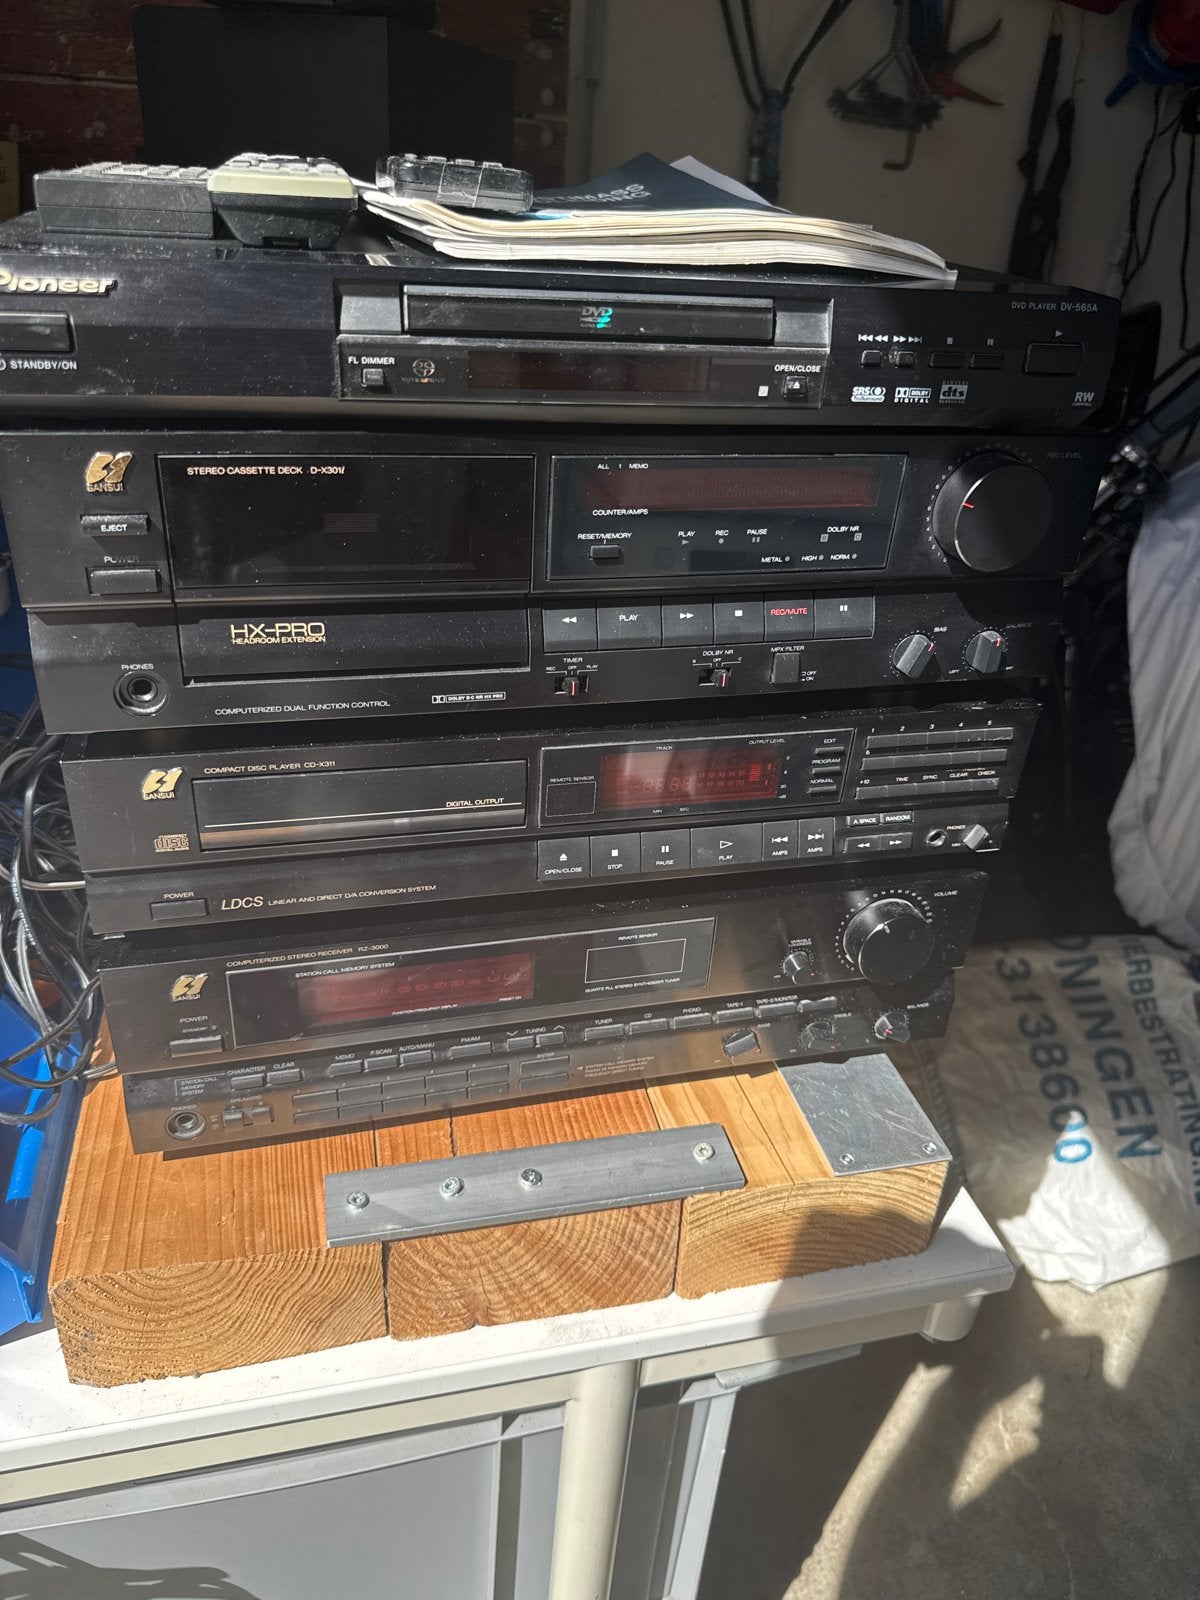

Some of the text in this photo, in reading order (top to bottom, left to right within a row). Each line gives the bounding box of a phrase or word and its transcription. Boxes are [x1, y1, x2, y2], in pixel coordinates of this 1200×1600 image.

[582, 306, 614, 317] DVD
[1028, 302, 1056, 310] PLAYER
[1060, 302, 1098, 312] DV-565A
[10, 360, 77, 370] STANDBY/ON
[348, 356, 395, 365] FL DIMMER
[774, 364, 821, 373] OPEN/CLOSE
[910, 389, 930, 397] DOLBY
[941, 385, 966, 399] dts
[1074, 392, 1094, 402] RW
[187, 466, 226, 476] STEREO
[226, 466, 276, 476] CASSETTE
[277, 466, 303, 475] DECK
[592, 508, 649, 517] COUNTER/AMPS
[100, 523, 128, 532] EJECT
[577, 532, 632, 540] RESET/MEMORY
[678, 530, 695, 538] PLAY
[770, 607, 808, 616] REC/MUTE
[619, 614, 638, 622] PLAY
[230, 621, 326, 639] HX-PRO
[232, 635, 327, 645] HEADROOM EXTENSION
[121, 663, 154, 671] PHONES
[214, 700, 391, 715] COMPUTERIZED DUAL FUNCTION CONTROL
[204, 760, 336, 774] COMPACT DISC PLAYER CD-X311
[446, 797, 504, 808] DIGITAL OUTPUT
[885, 814, 910, 822] RANDOM
[544, 866, 583, 875] OPEN/CLOSE
[163, 891, 195, 899] POWER
[221, 896, 264, 910] LDCS
[359, 887, 406, 897] CONVERSION
[407, 885, 437, 893] SYSTEM
[226, 944, 389, 967] COMPUTERIZED STEREO RECEIVER RZ-3000
[295, 970, 321, 978] STATION
[340, 965, 369, 973] MEMORY
[682, 1006, 701, 1014] PHONO
[179, 1015, 208, 1023] POWER
[525, 1026, 546, 1034] TUNING
[399, 1042, 435, 1052] AUTO/MANU
[335, 1053, 355, 1061] MEMO
[227, 1065, 266, 1076] CHARACTER
